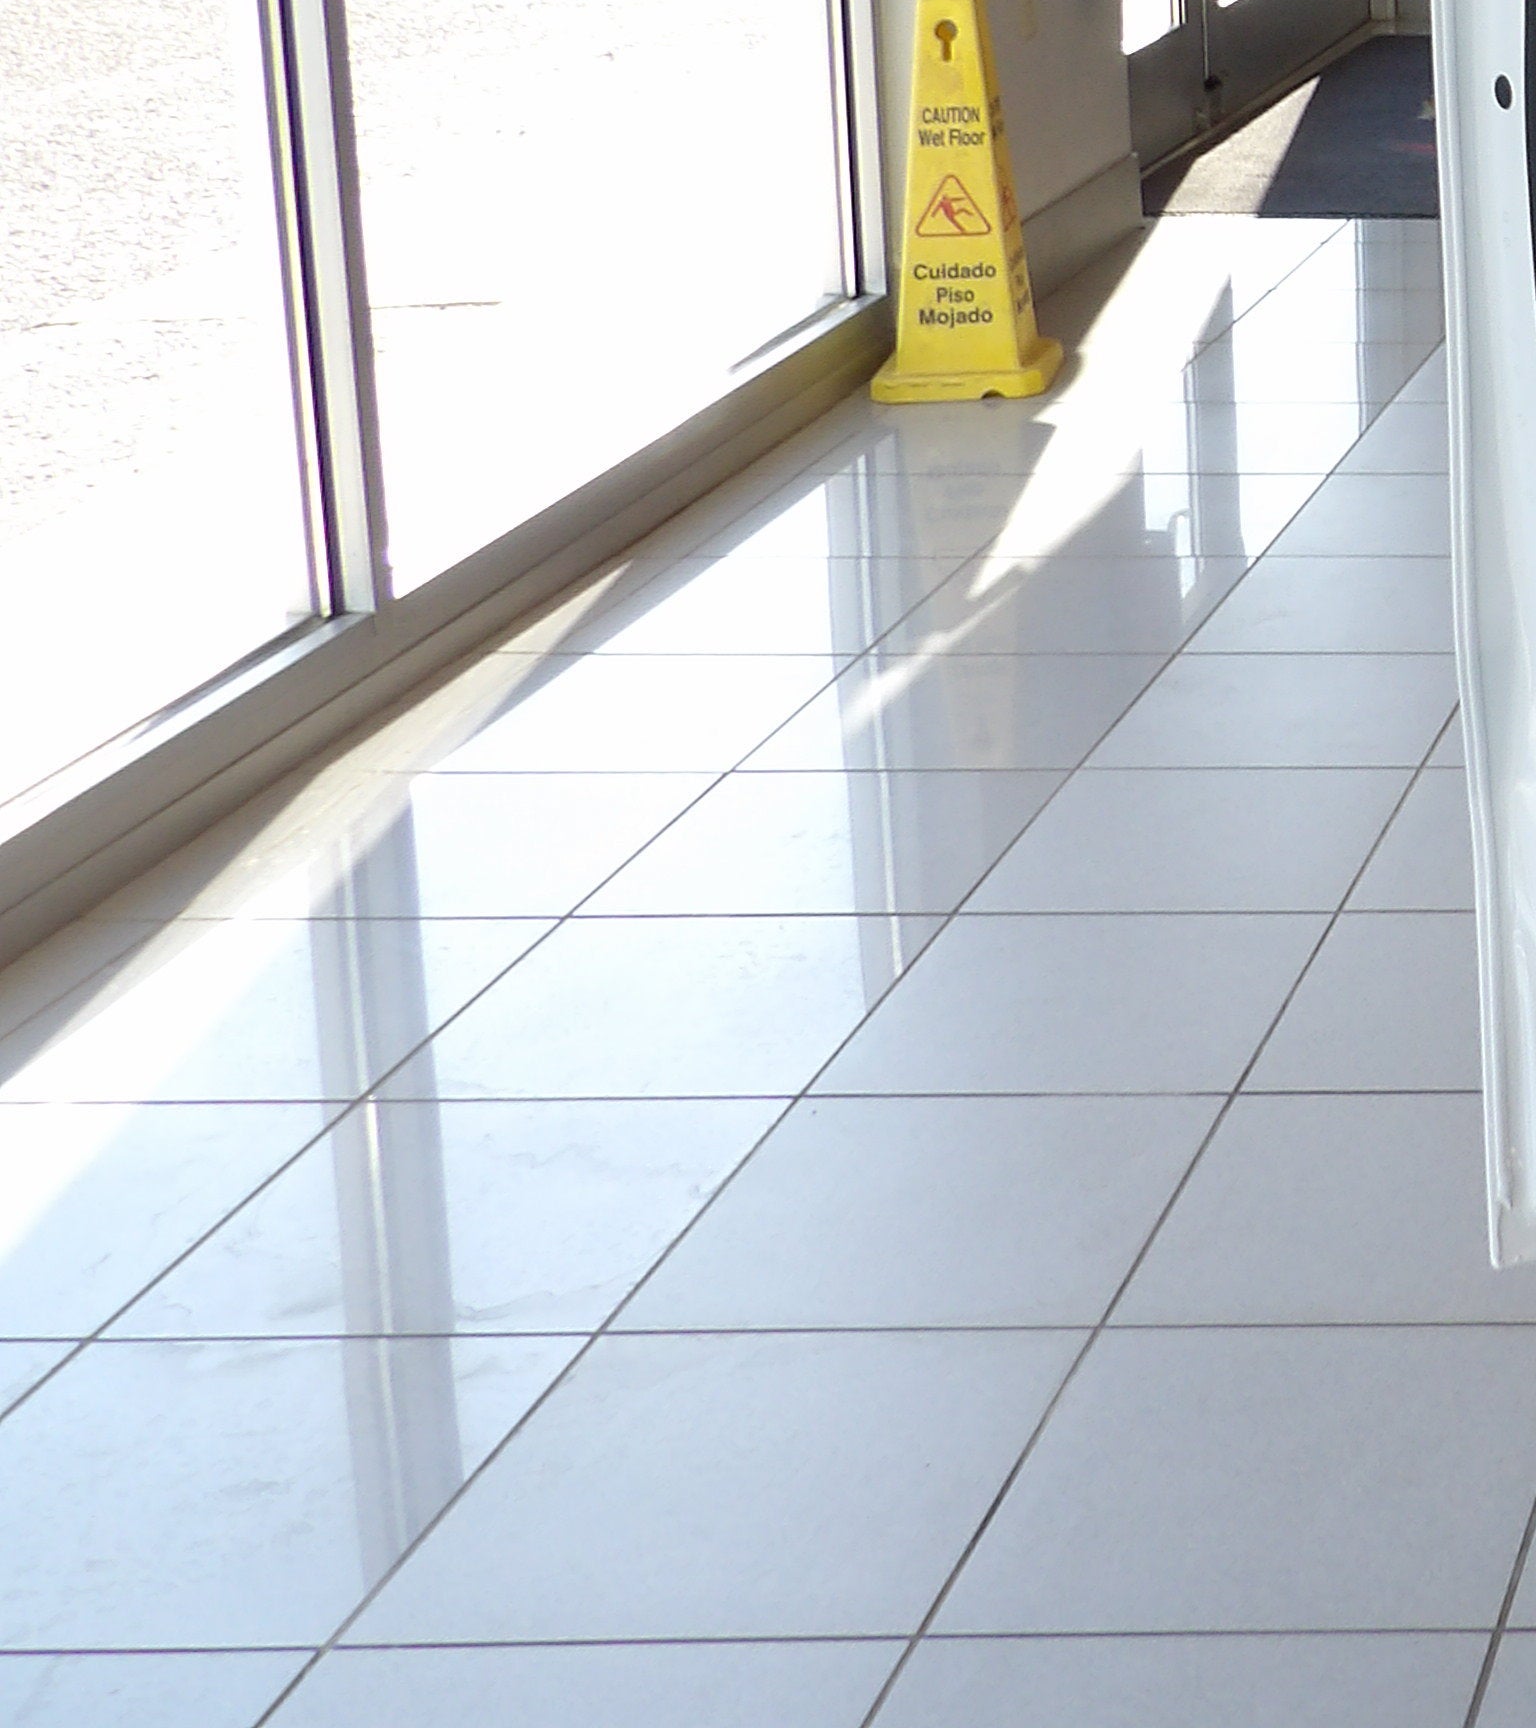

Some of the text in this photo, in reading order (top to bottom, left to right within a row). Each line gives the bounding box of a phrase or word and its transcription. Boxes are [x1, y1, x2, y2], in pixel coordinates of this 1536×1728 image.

[922, 106, 980, 124] CAUTION
[918, 128, 986, 146] Wet Floor
[913, 262, 997, 280] Cuidado
[936, 286, 975, 303] Piso
[919, 307, 993, 328] Mojado
